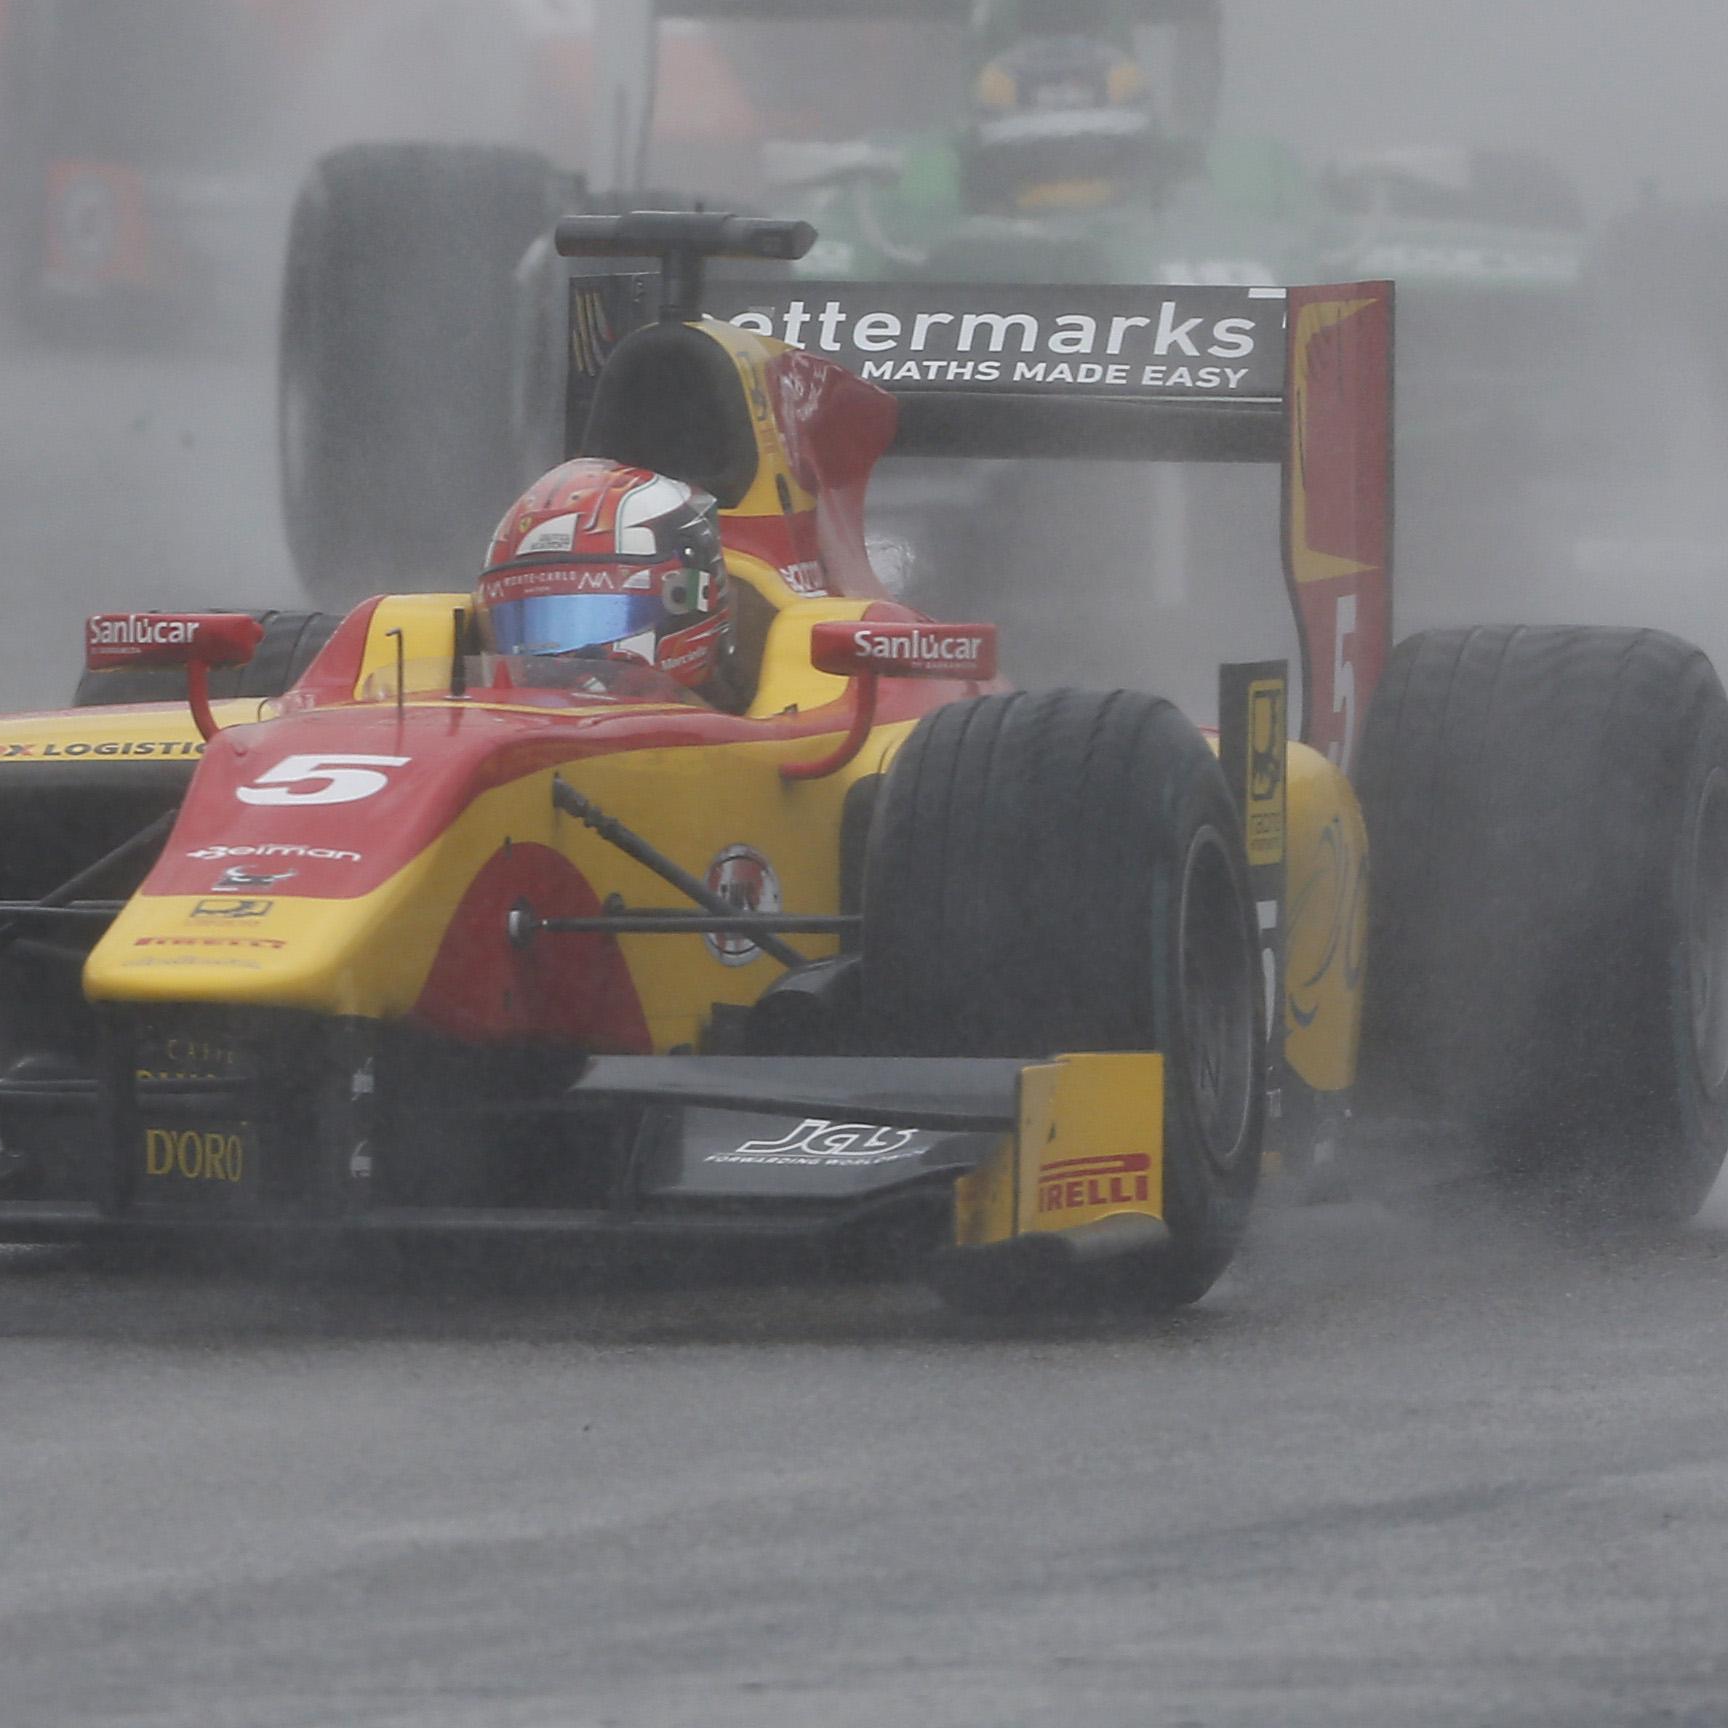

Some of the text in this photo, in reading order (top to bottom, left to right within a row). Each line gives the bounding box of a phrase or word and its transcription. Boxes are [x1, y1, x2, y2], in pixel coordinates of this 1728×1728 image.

[702, 301, 1257, 358] ettermarks
[861, 360, 1249, 389] MATHS MADE EASY
[90, 614, 200, 644] Sanlúcar
[854, 628, 983, 660] Sanlúcar
[236, 753, 412, 806] 5
[145, 1128, 243, 1183] D'ORO
[704, 1155, 820, 1165] FORWARDING
